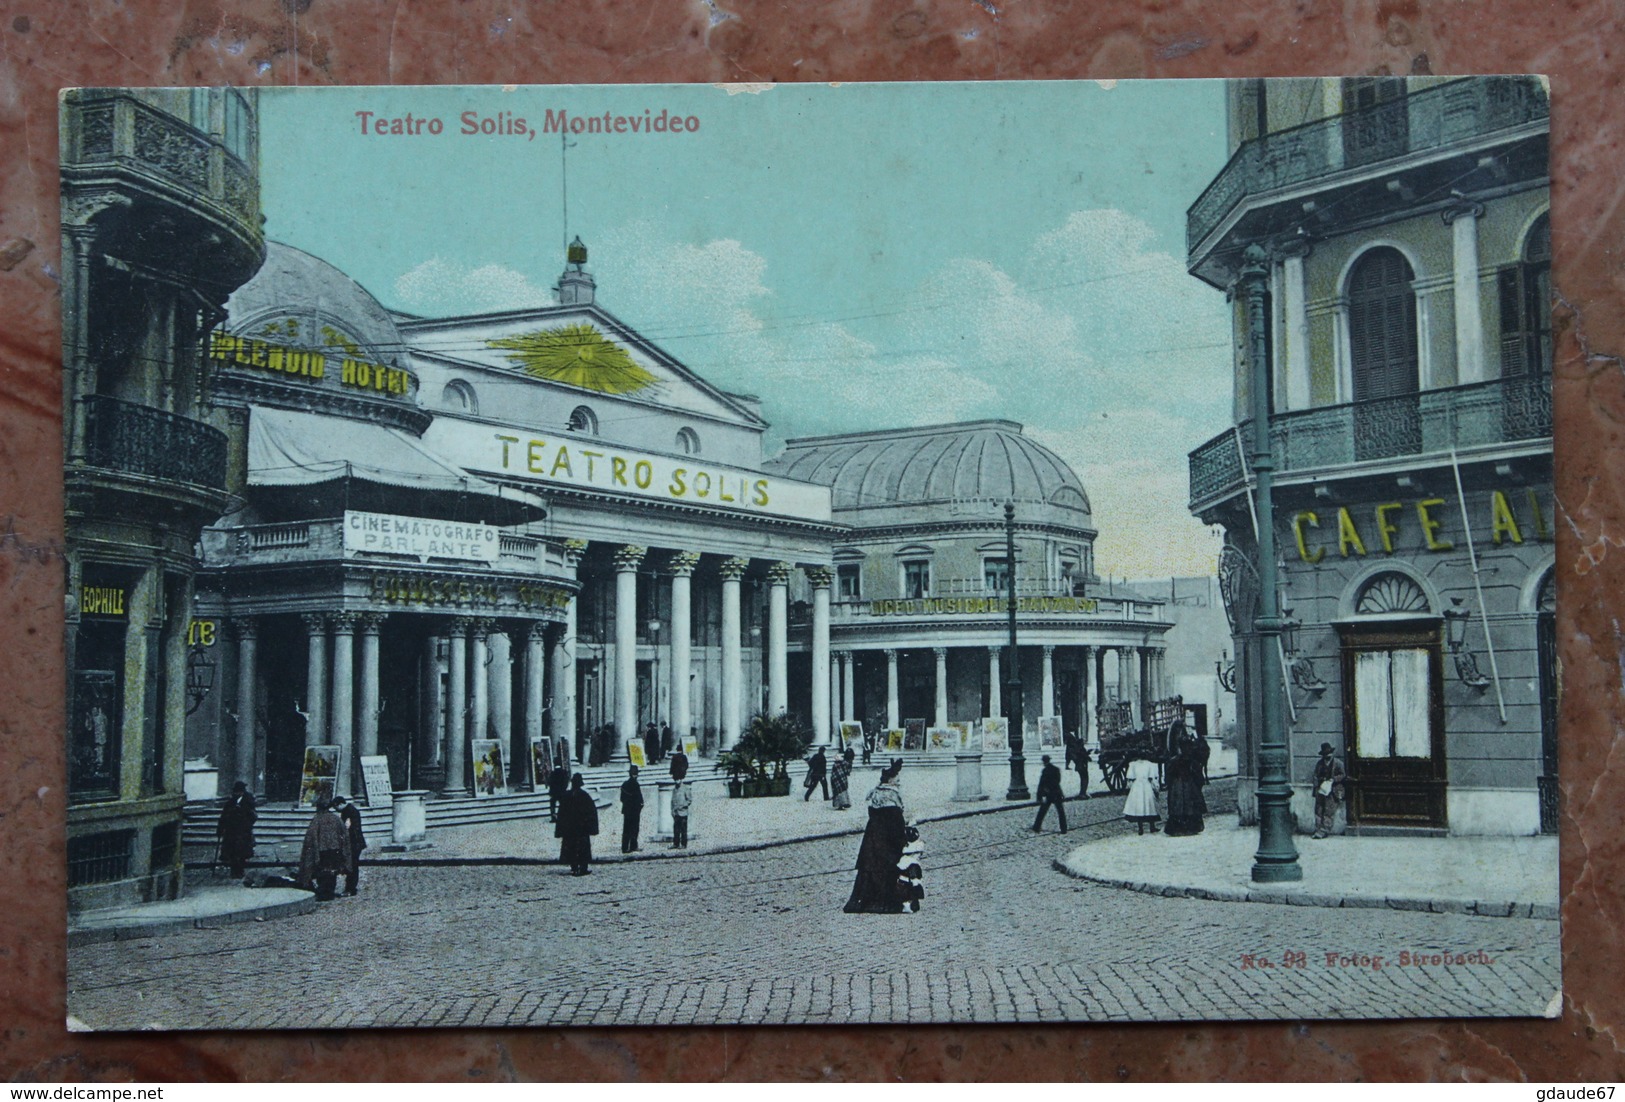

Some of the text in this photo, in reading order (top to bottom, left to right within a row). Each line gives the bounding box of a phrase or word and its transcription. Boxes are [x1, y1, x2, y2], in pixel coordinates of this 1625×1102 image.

[354, 108, 701, 142] Teatro Solis, Montevideo
[341, 358, 408, 395] HOTEL
[494, 433, 770, 507] TEATRO SOLIS
[350, 515, 494, 542] CINEMATOGRAFO
[1291, 498, 1454, 564] CAFE
[364, 533, 482, 558] PARLANTE
[922, 598, 999, 615] MUSICAL
[1240, 953, 1275, 970] No.
[1283, 950, 1307, 969] 93
[1324, 951, 1390, 971] Fotog.
